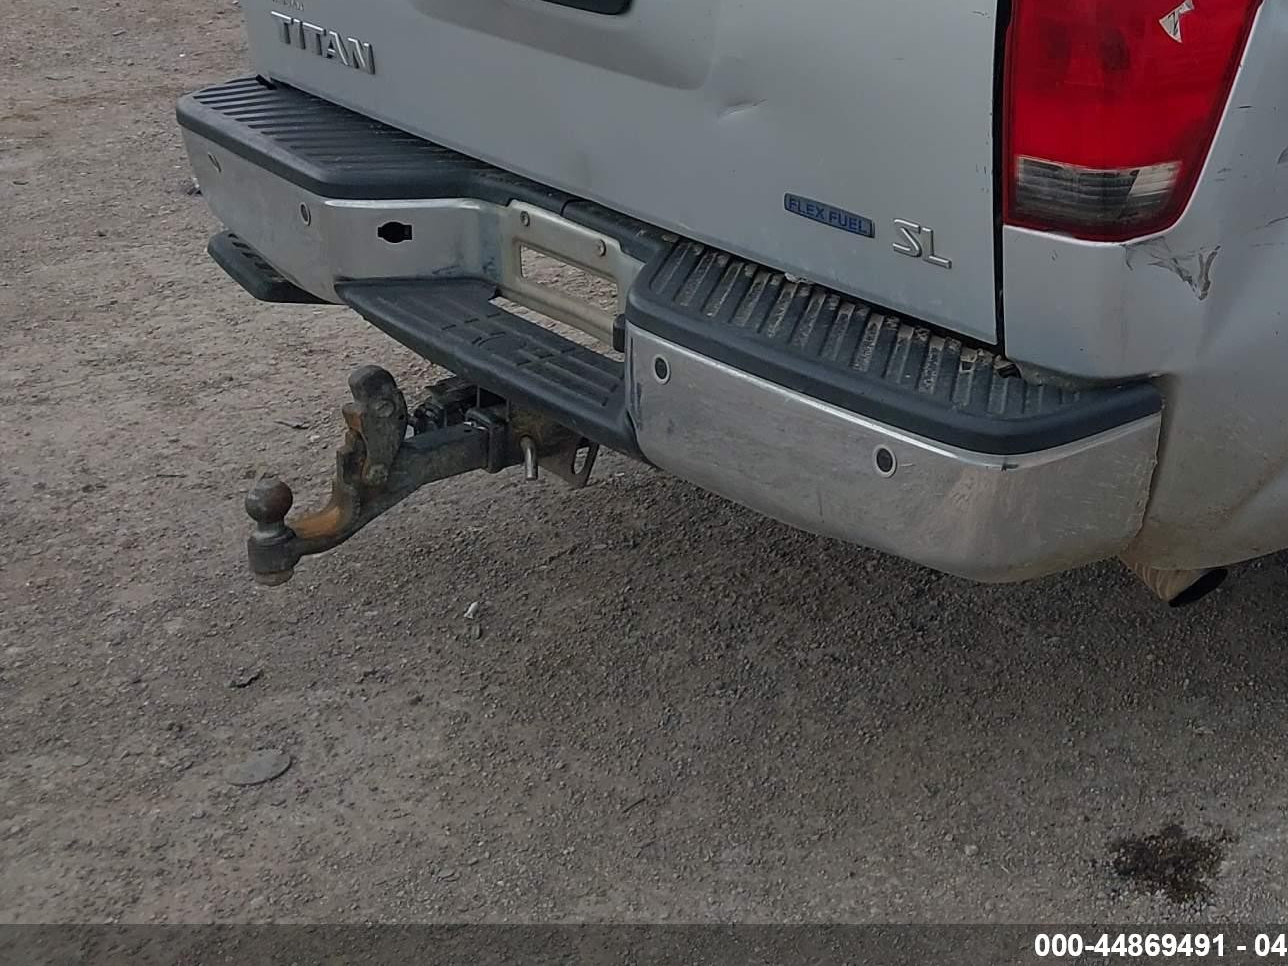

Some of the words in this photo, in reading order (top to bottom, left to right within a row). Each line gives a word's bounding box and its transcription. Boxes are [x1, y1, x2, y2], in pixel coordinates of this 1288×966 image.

[271, 10, 376, 75] TITAN
[787, 196, 826, 220] FLEX
[828, 212, 869, 235] FUEL
[892, 218, 952, 270] SL
